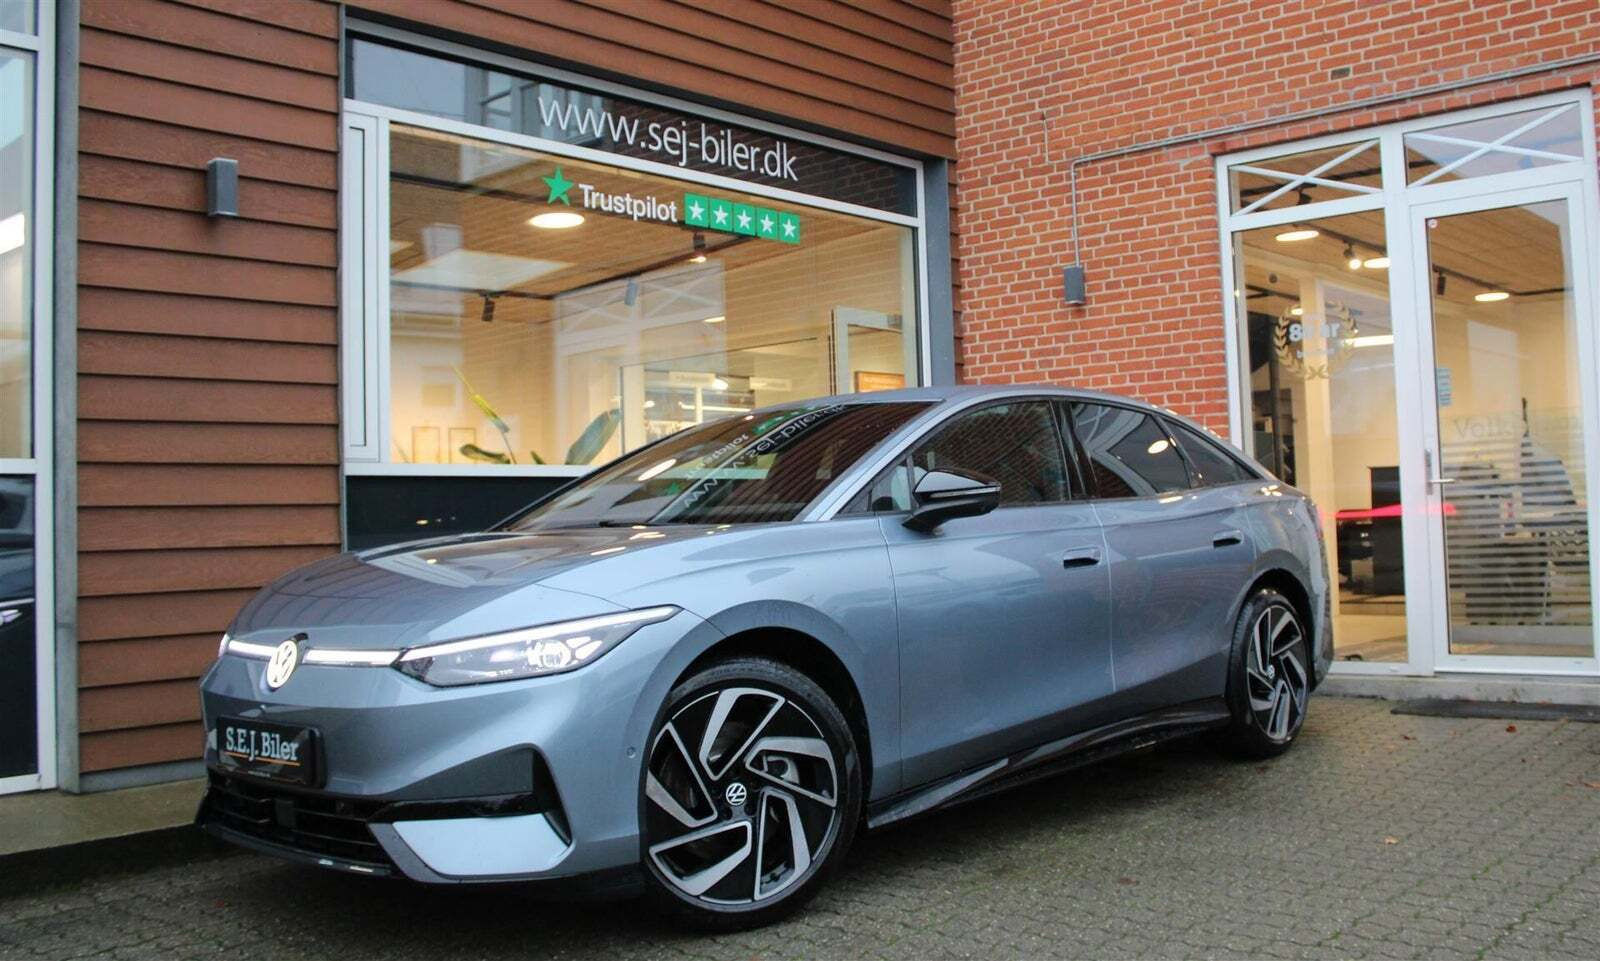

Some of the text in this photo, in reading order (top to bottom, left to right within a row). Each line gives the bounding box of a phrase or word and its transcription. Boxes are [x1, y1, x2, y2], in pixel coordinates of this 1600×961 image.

[538, 96, 799, 182] www.sej-biler.dk
[578, 184, 677, 222] Trustpilot
[226, 726, 299, 762] S.E.J. Biler
